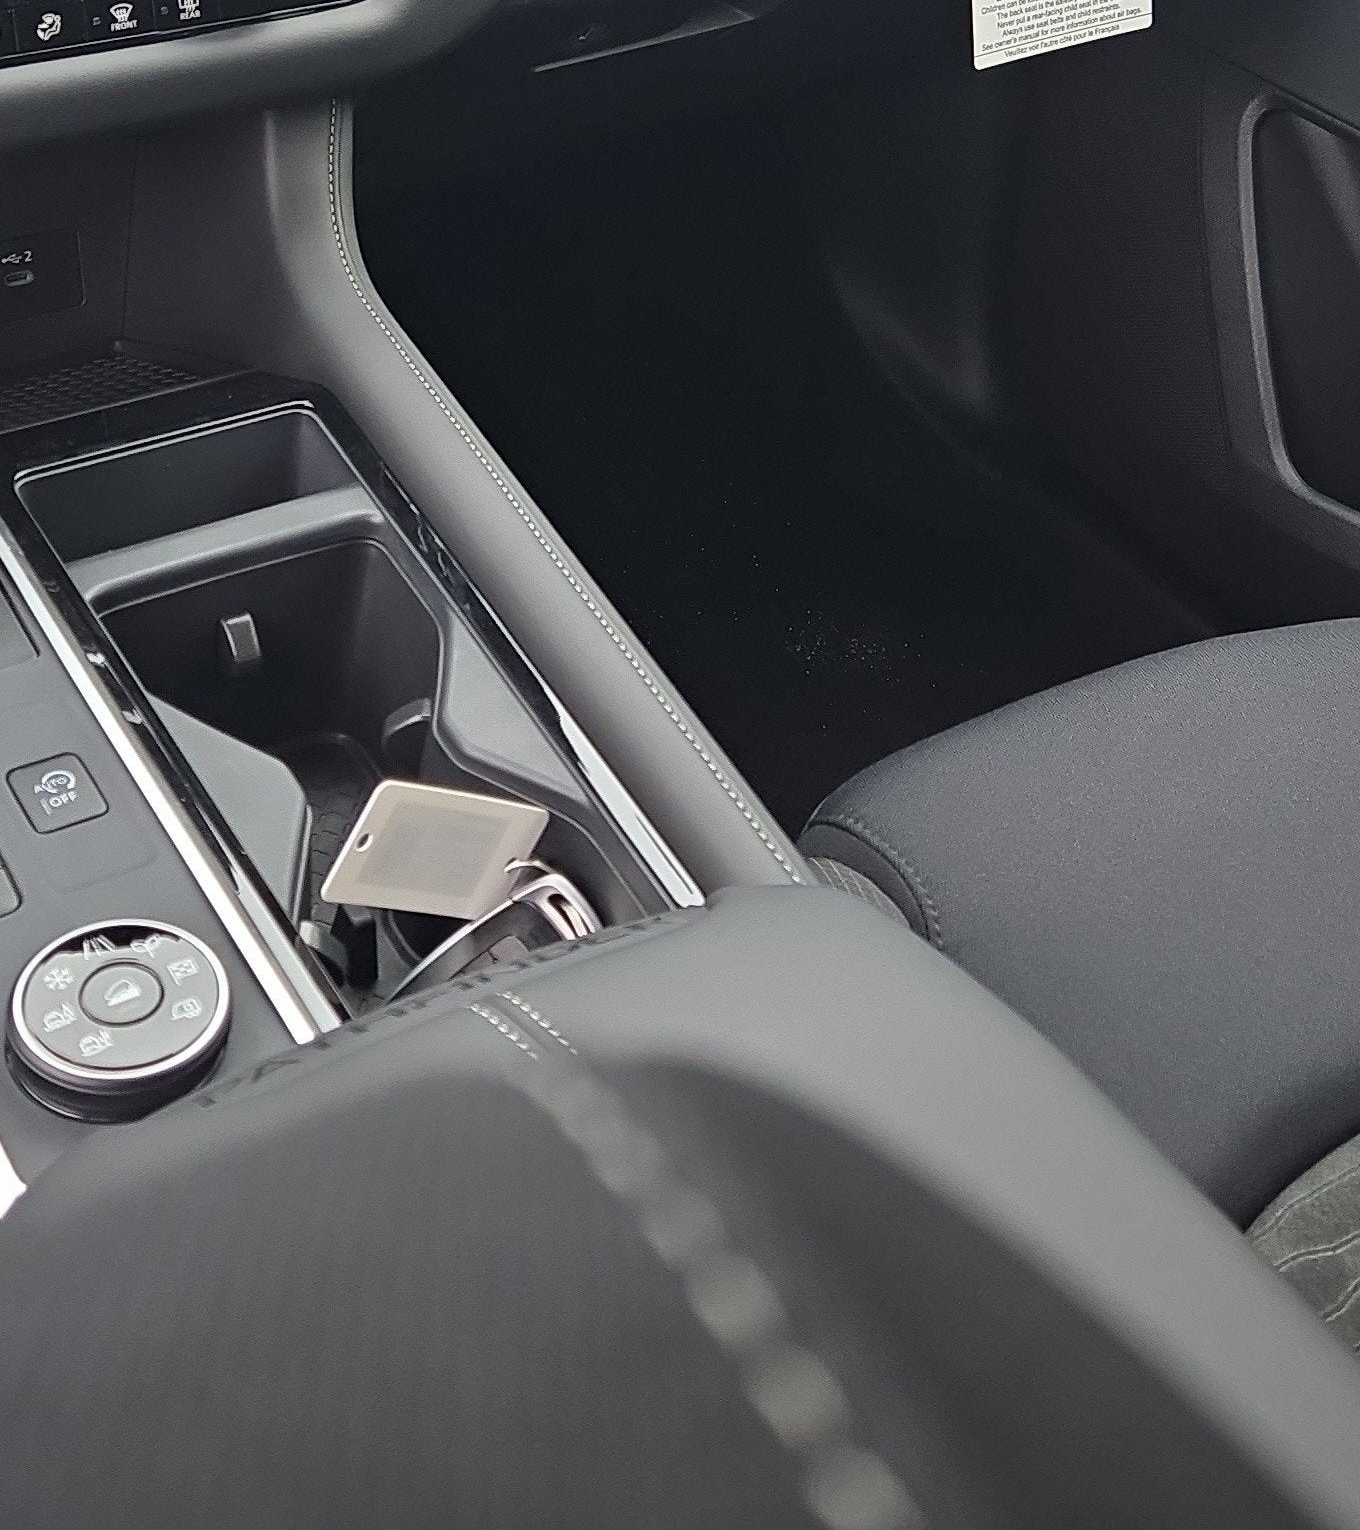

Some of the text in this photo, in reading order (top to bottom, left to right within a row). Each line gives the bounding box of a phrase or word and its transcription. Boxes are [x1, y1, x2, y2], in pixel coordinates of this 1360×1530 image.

[179, 10, 201, 21] REAR
[981, 3, 1005, 15] Children
[997, 12, 1008, 20] The
[1009, 8, 1023, 17] back
[1025, 5, 1037, 13] seat
[997, 20, 1015, 29] Never
[1016, 17, 1026, 26] put
[1064, 3, 1078, 13] child
[1079, 0, 1092, 9] seat
[110, 20, 138, 32] FRONT
[1002, 27, 1023, 37] Always
[1036, 20, 1049, 28] seat
[1050, 17, 1064, 25] belts
[1065, 13, 1077, 21] and
[1077, 9, 1092, 18] child
[982, 43, 994, 52] See
[994, 36, 1017, 48] owner's
[1018, 31, 1040, 42] manual
[1041, 28, 1049, 36] for
[1050, 25, 1065, 33] more
[1066, 17, 1098, 29] information
[1099, 13, 1116, 22] about
[1005, 46, 1028, 57] Veuillez
[1073, 32, 1087, 41] pour
[1094, 24, 1120, 35] Français
[23, 251, 32, 262] 2
[49, 791, 76, 807] OFF
